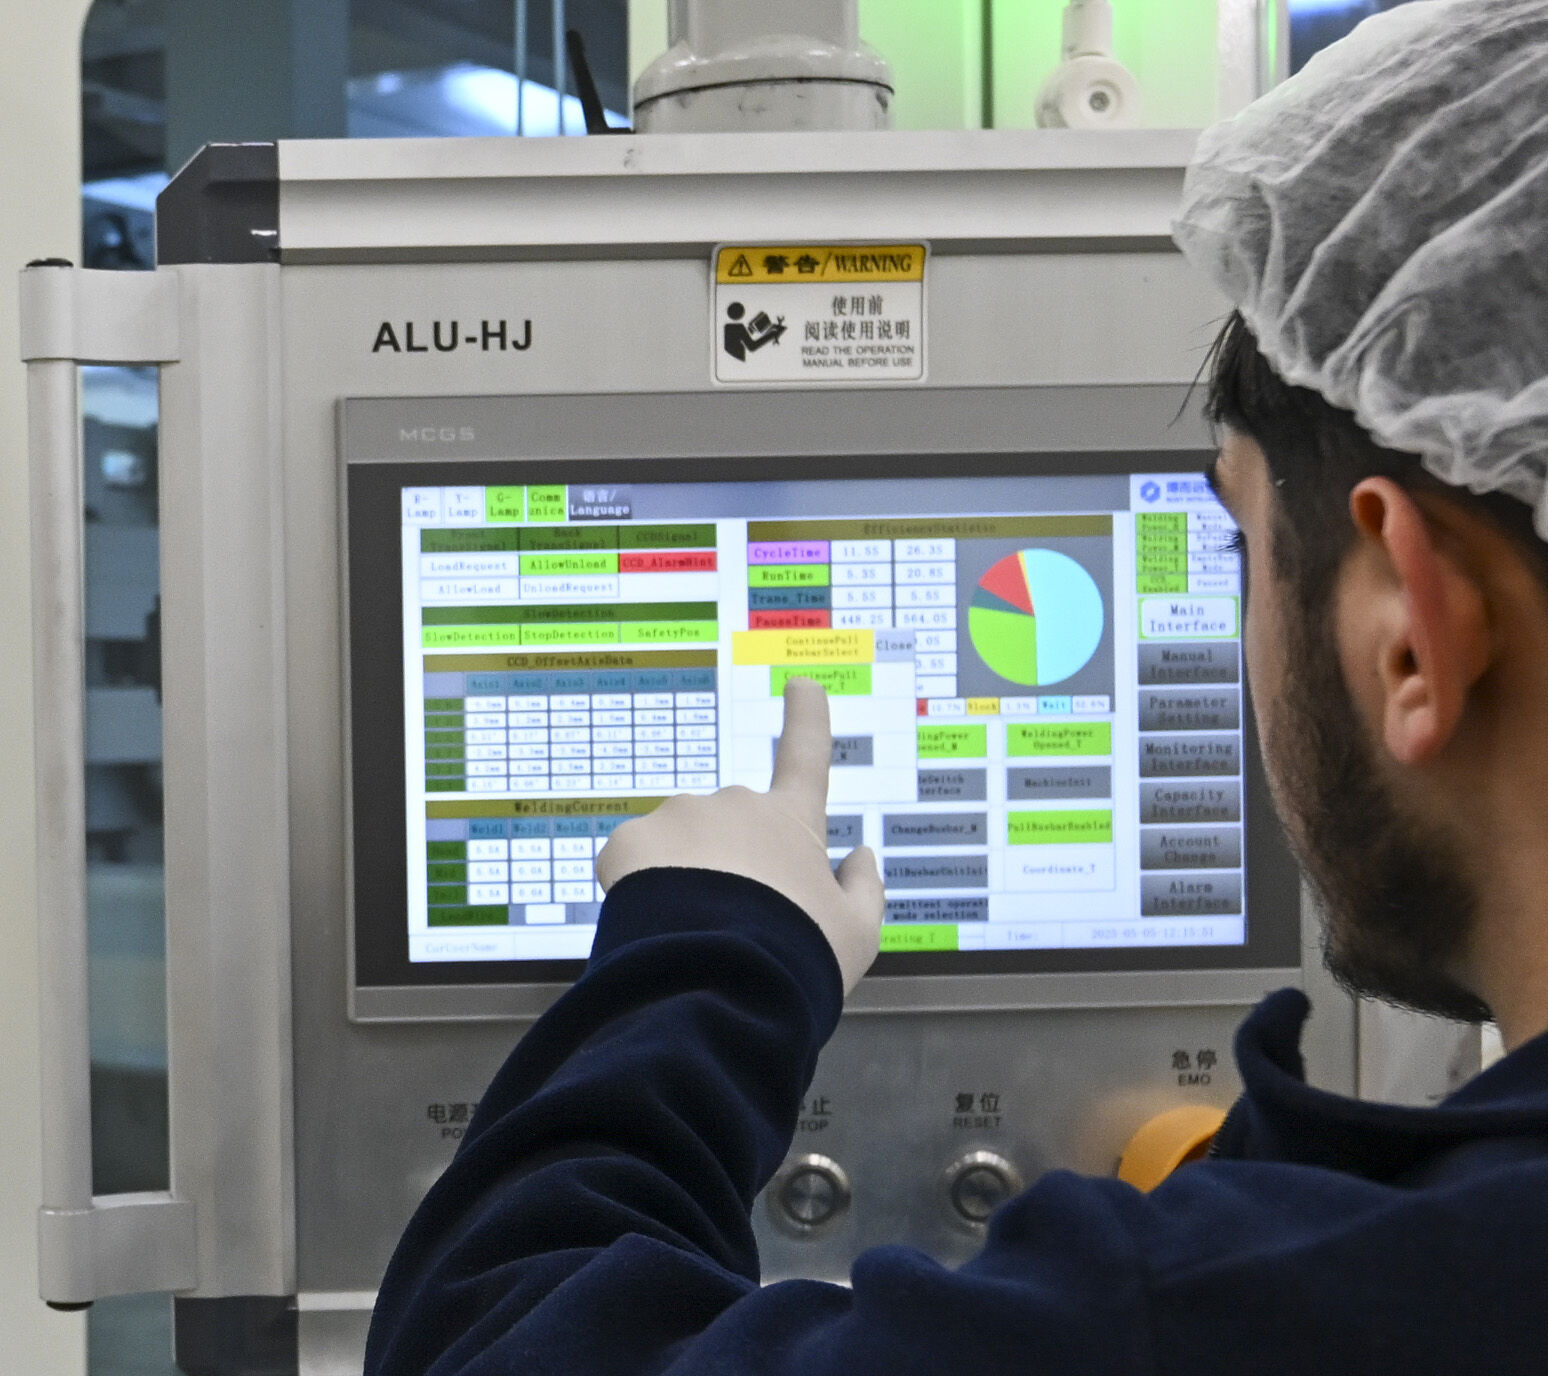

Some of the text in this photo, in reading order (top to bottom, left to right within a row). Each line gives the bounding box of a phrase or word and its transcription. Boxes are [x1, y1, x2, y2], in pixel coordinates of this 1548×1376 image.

[832, 294, 884, 316] 使用前
[805, 319, 911, 341] 阅读使用说明
[372, 320, 534, 354] ALU-HJ
[802, 345, 914, 355] READ THE OPERATION
[803, 358, 913, 368] MANUAL BEFORE USE
[400, 426, 475, 443] MCGS
[489, 506, 520, 518] Lamp
[570, 503, 631, 517] Language
[754, 548, 821, 561] CycleTime
[430, 561, 507, 573] LoadRequest
[530, 558, 607, 570] AllowUnload
[762, 571, 813, 581] RunTime
[438, 584, 501, 595] AllowLoad
[523, 582, 613, 595] UnloadRequest
[1170, 604, 1204, 616] Main
[1150, 620, 1226, 633] Interface
[425, 630, 516, 642] SlowDetection
[524, 628, 615, 641] StopDetection
[786, 635, 859, 646] ContinuePull
[876, 640, 913, 651] Close
[1162, 650, 1213, 663] Manual
[1150, 667, 1227, 679] Interface
[1150, 697, 1227, 709] Parameter
[1146, 743, 1232, 756] Monitoring
[1151, 758, 1228, 771] Interface
[1155, 789, 1224, 804] Capacity
[515, 800, 629, 814] WeldingCurrent
[1152, 805, 1229, 817] Interface
[1160, 836, 1220, 848] Account
[1164, 851, 1216, 864] Change
[1169, 882, 1213, 894] Alarm
[1154, 897, 1229, 910] Interface
[1171, 1050, 1217, 1070] 急停
[1178, 1074, 1211, 1086] EMO
[955, 1092, 1000, 1113] 复位
[793, 1120, 829, 1132] TOP
[953, 1116, 1001, 1128] RESET
